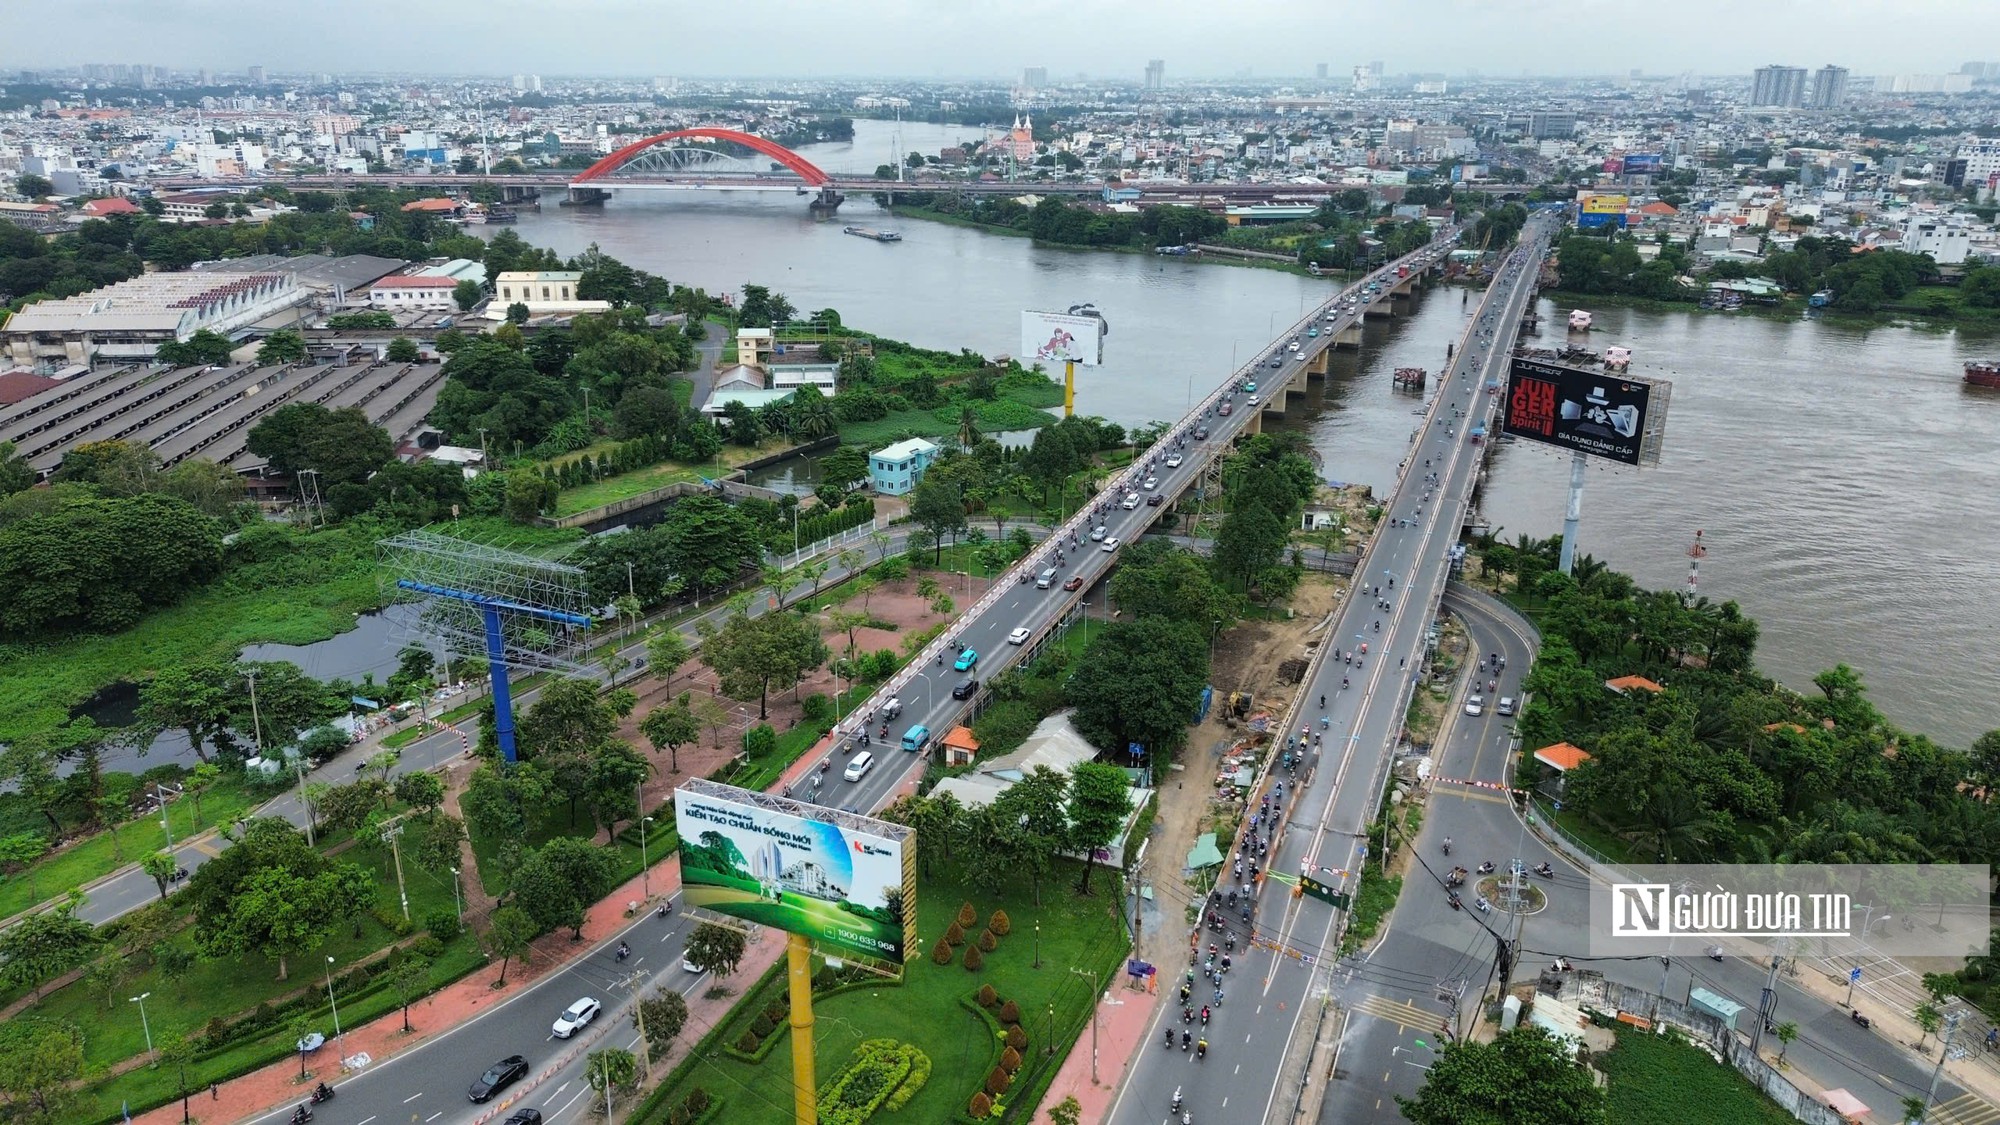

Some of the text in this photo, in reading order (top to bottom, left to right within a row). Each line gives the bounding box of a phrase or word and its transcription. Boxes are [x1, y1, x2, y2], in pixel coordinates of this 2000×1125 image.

[1514, 378, 1555, 400] JUN
[1512, 391, 1555, 417] GER
[1511, 416, 1541, 431] spirit
[685, 808, 812, 845] KIẾN TẠO CHUẨN SỐNG MỚI
[838, 929, 895, 952] 1900 633 968
